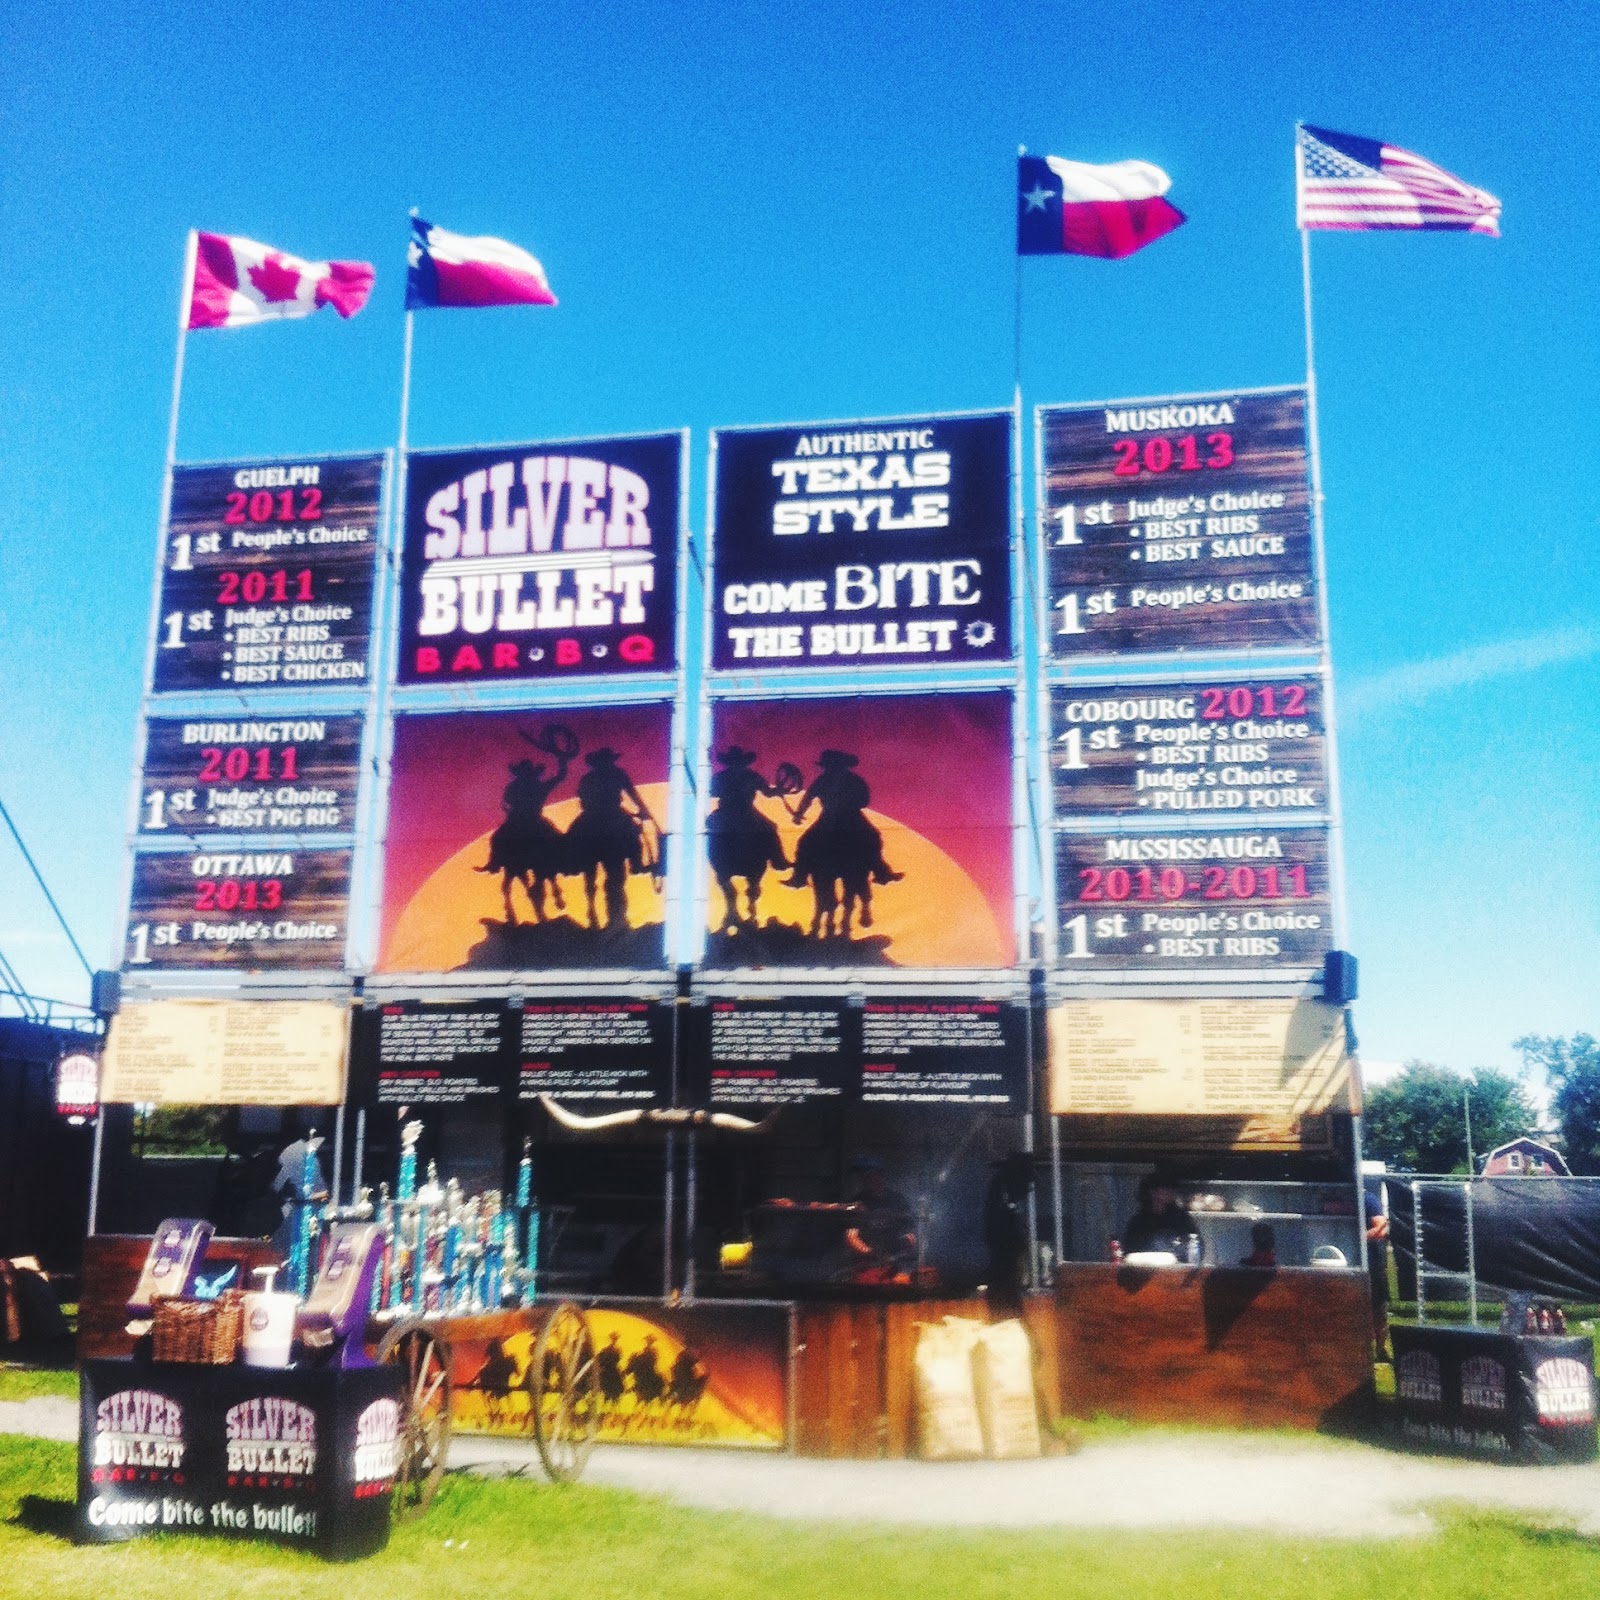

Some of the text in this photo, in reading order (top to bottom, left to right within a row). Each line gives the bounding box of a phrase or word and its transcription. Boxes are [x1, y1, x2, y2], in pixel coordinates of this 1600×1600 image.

[1104, 403, 1235, 433] MUSKOKA
[795, 429, 934, 456] AUTHENTIC
[1113, 432, 1235, 476] 2013
[234, 465, 321, 489] GUELPH
[771, 451, 951, 495] TEXAS
[224, 488, 323, 525] 2012
[424, 456, 652, 560] SILVER
[772, 493, 950, 536] STYLE
[1128, 496, 1205, 521] Judge's
[1209, 490, 1286, 511] Choice
[231, 529, 306, 551] People's
[308, 526, 369, 544] Choice
[1144, 515, 1259, 540] BEST RIBS
[1145, 536, 1286, 564] BEST SAUCE
[217, 569, 315, 606] 2011
[418, 565, 655, 636] BULLET
[723, 559, 982, 615] COME BITE
[1130, 586, 1222, 609] People's
[1227, 581, 1302, 602] Choice
[224, 606, 290, 628] Judge's
[291, 604, 353, 623] Choice
[236, 624, 330, 644] BEST RIBS
[728, 620, 958, 658] THE BULLET
[235, 643, 344, 663] BEST SAUCE
[233, 662, 366, 683] BEST CHICKEN
[1065, 685, 1308, 723] COBOURG 2012
[182, 721, 326, 745] BURLINGTON
[1134, 723, 1229, 746] People's
[1232, 721, 1310, 739] Choice
[198, 746, 300, 782] 2011
[1151, 744, 1269, 765] BEST RIBS
[1135, 766, 1297, 791] Judge's Choice
[207, 788, 273, 809] Judge's
[275, 786, 338, 804] Choice
[1155, 788, 1317, 810] PULLED PORK
[219, 808, 267, 827] BEST
[306, 807, 340, 825] RIG
[1105, 836, 1283, 861] MISSISSAUGA
[191, 855, 294, 877] OTTAWA
[194, 879, 283, 912] 2013
[1078, 864, 1311, 902] 2010-2011
[192, 922, 270, 943] People's
[273, 921, 338, 940] Choice
[1142, 912, 1238, 936] People's
[1241, 912, 1321, 931] Choice
[1160, 937, 1281, 958] BEST RIBS
[97, 1389, 182, 1437] SILVER
[226, 1397, 315, 1441] SILVER
[95, 1438, 186, 1468] BULLET
[227, 1446, 317, 1475] BULLET
[88, 1497, 159, 1526] Come
[162, 1497, 204, 1525] bite
[210, 1501, 249, 1529] the
